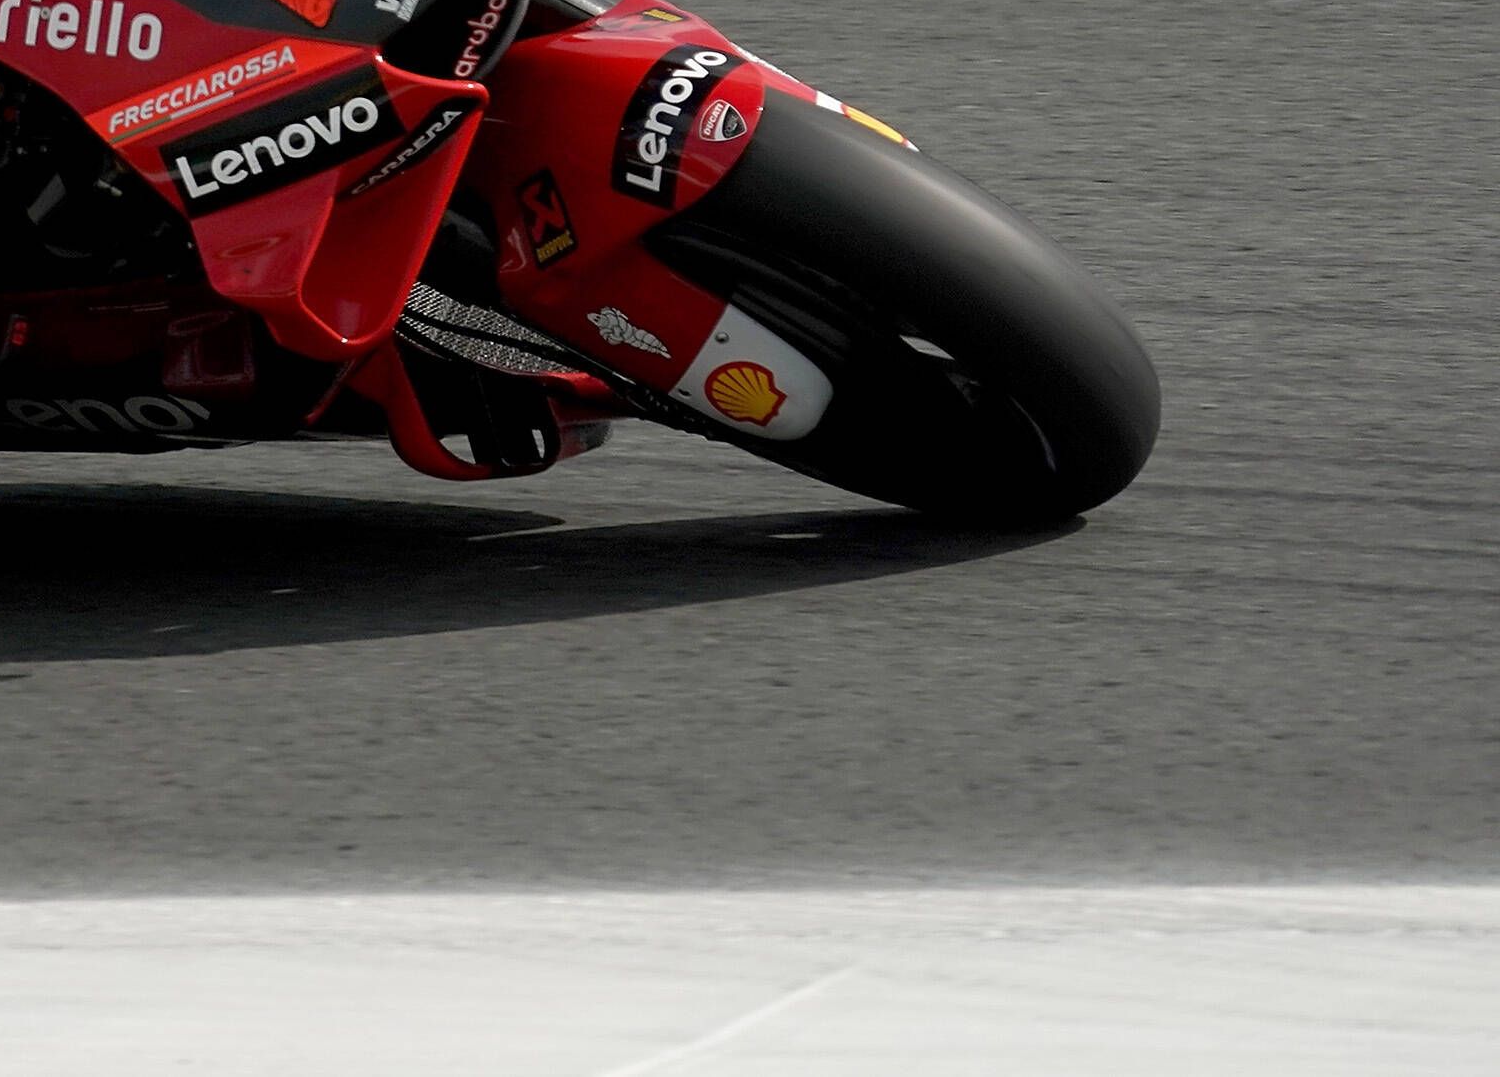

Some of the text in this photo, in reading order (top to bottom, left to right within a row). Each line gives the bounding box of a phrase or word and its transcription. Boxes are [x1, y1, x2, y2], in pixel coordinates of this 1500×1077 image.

[108, 45, 296, 133] FRECCIAROSSA
[626, 50, 728, 193] Lenovo
[703, 103, 725, 135] DUCATI
[176, 97, 379, 199] Lenovo
[350, 108, 462, 196] CARRERA
